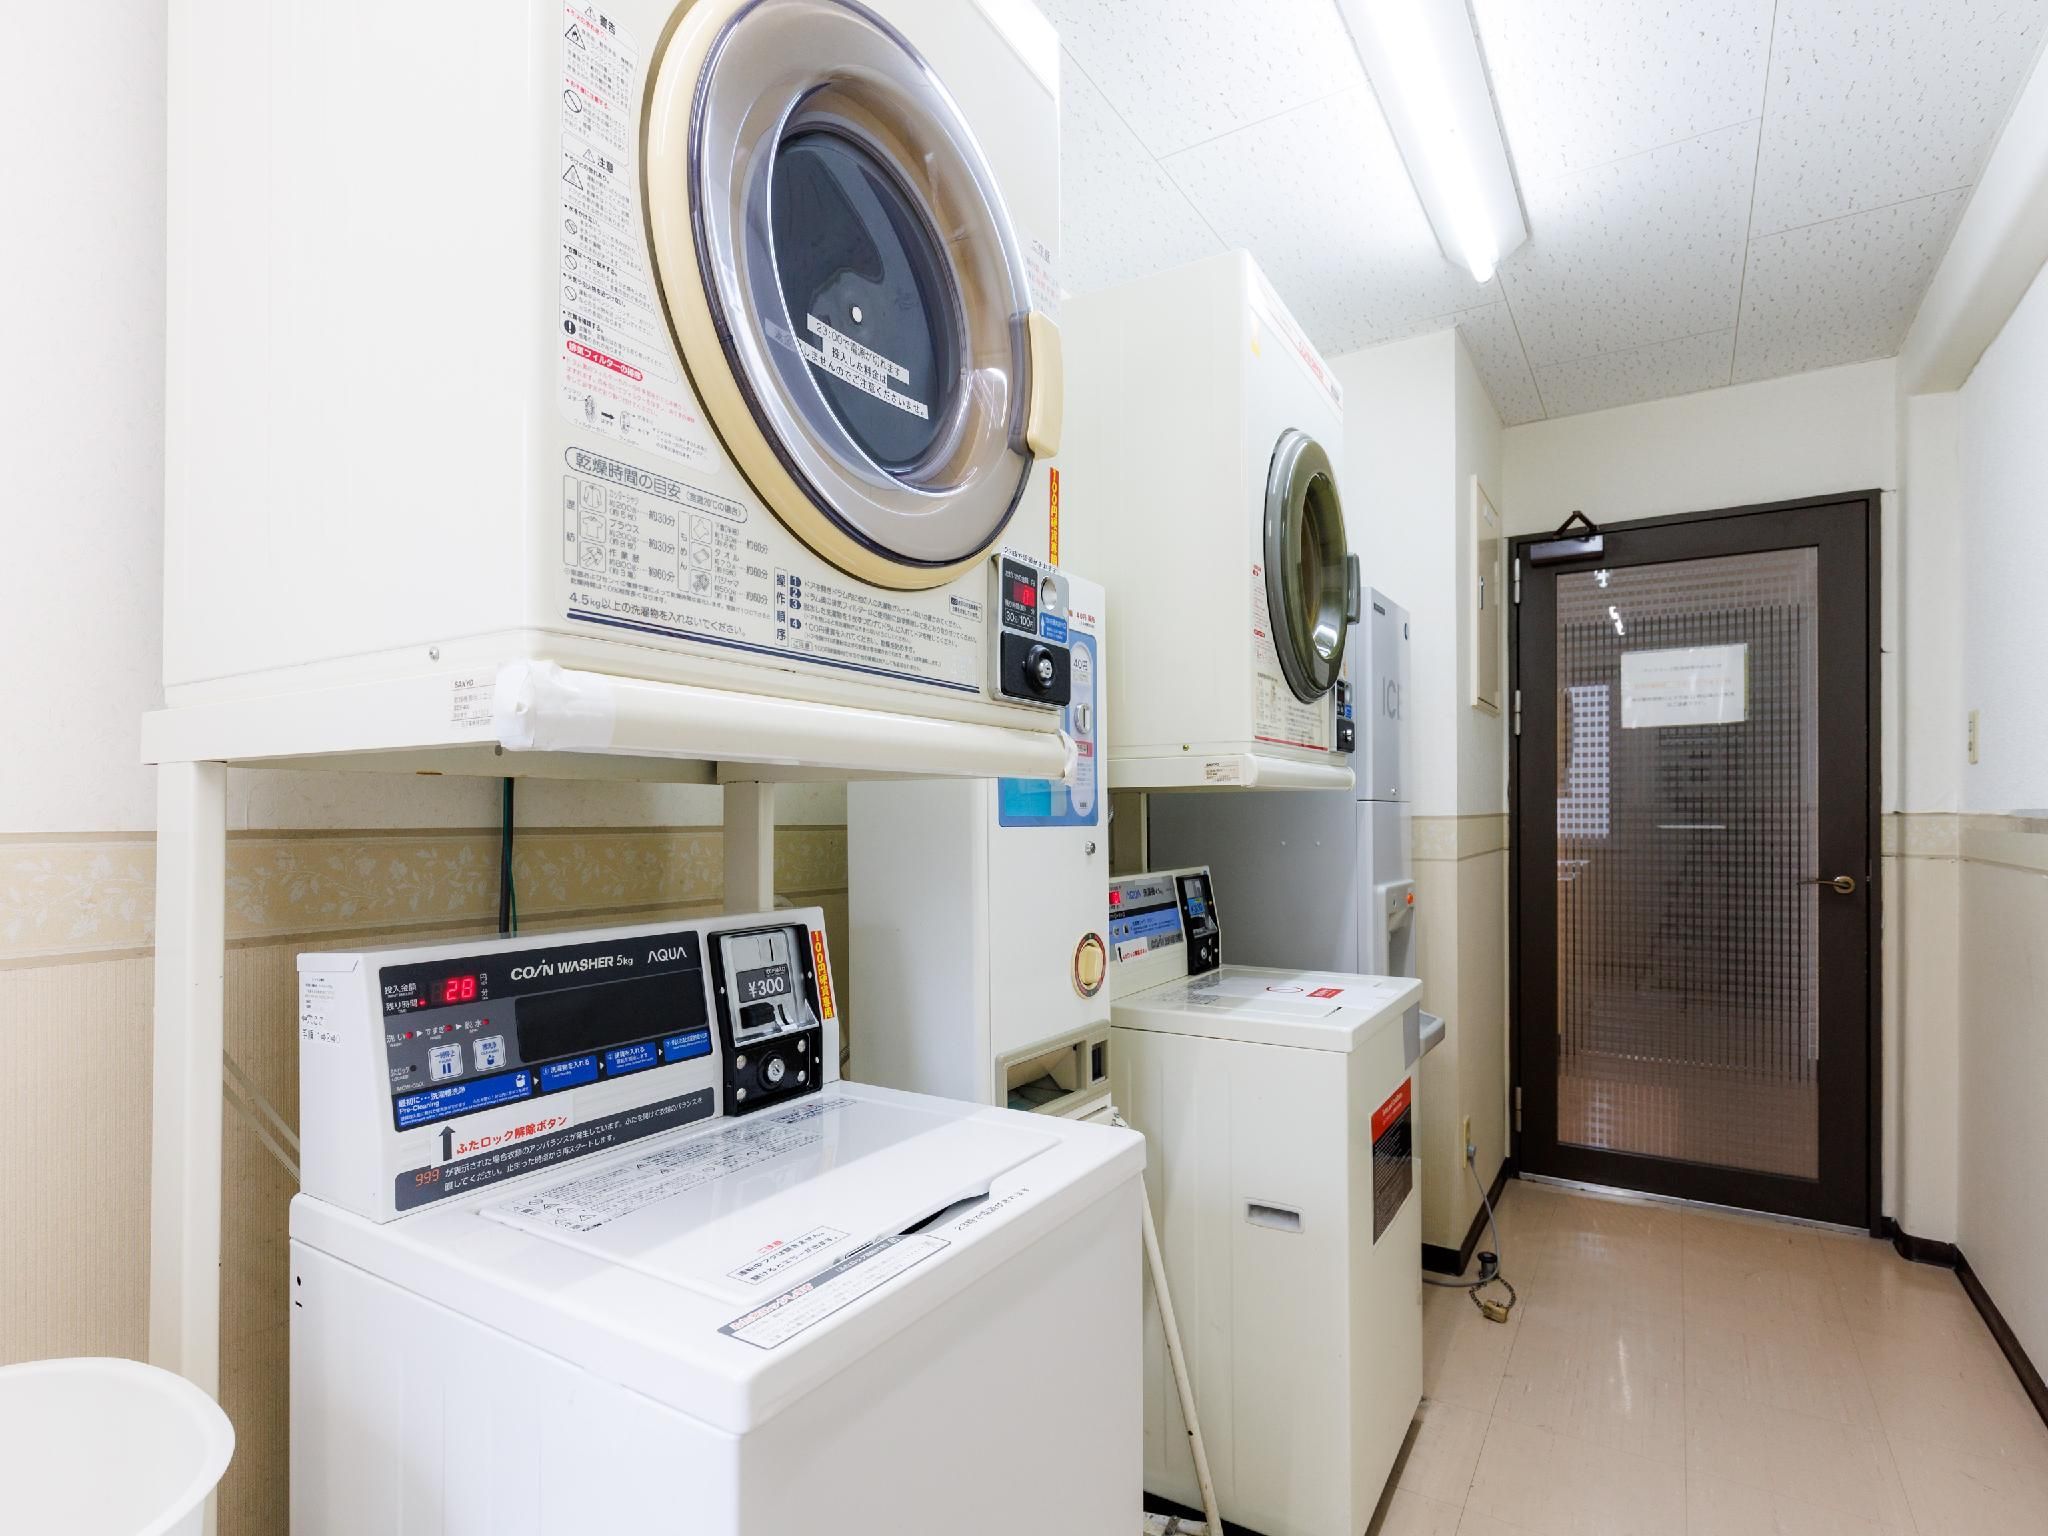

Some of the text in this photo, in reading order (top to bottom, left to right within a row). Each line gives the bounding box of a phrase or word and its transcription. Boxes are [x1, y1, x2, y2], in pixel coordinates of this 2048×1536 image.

[597, 156, 613, 174] 注意
[832, 347, 886, 383] 投入した料金は
[576, 452, 680, 500] 乾燥時間の目安
[680, 533, 688, 570] もめん
[715, 549, 739, 561] タオル
[776, 575, 786, 641] 操作順序
[511, 946, 687, 981] COIN WASHER 5kg AQUA
[813, 931, 833, 1018] 100円硬貨専用
[384, 982, 417, 993] 投入金額
[446, 977, 475, 1001] 28
[480, 988, 488, 997] 分
[749, 977, 784, 998] ¥300
[386, 999, 417, 1011] 残り時間
[465, 1019, 482, 1030] 脱水
[399, 1100, 439, 1114] Pre-Cleaning
[456, 1116, 568, 1154] ふたロック解除ボタン
[415, 1168, 439, 1186] 999
